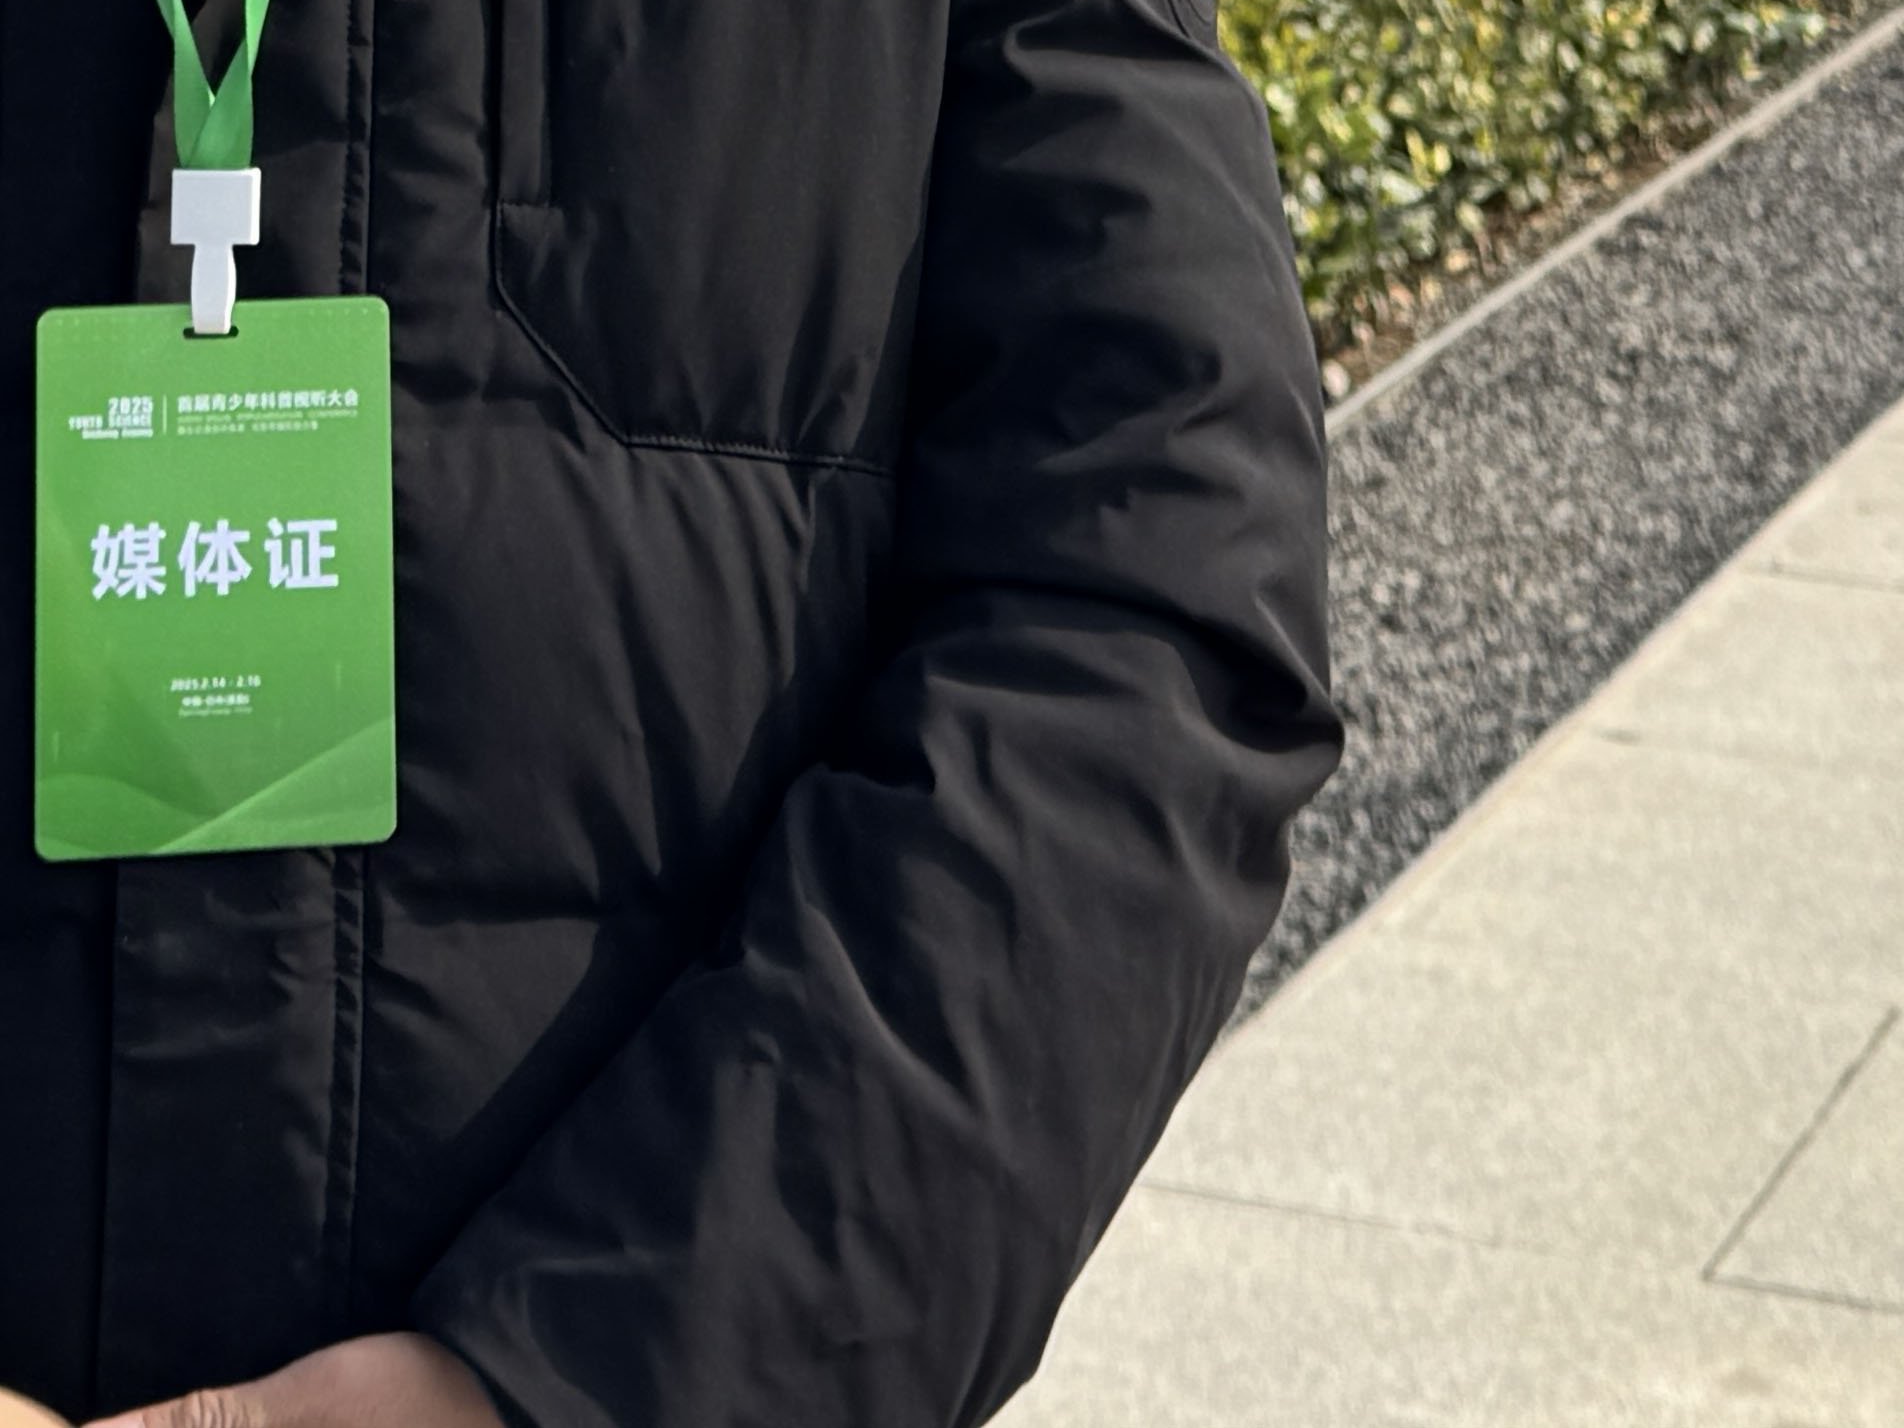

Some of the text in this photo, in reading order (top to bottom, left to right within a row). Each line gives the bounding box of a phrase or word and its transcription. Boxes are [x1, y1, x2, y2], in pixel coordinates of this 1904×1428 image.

[107, 395, 154, 415] 2025
[90, 516, 340, 601] 媒体证
